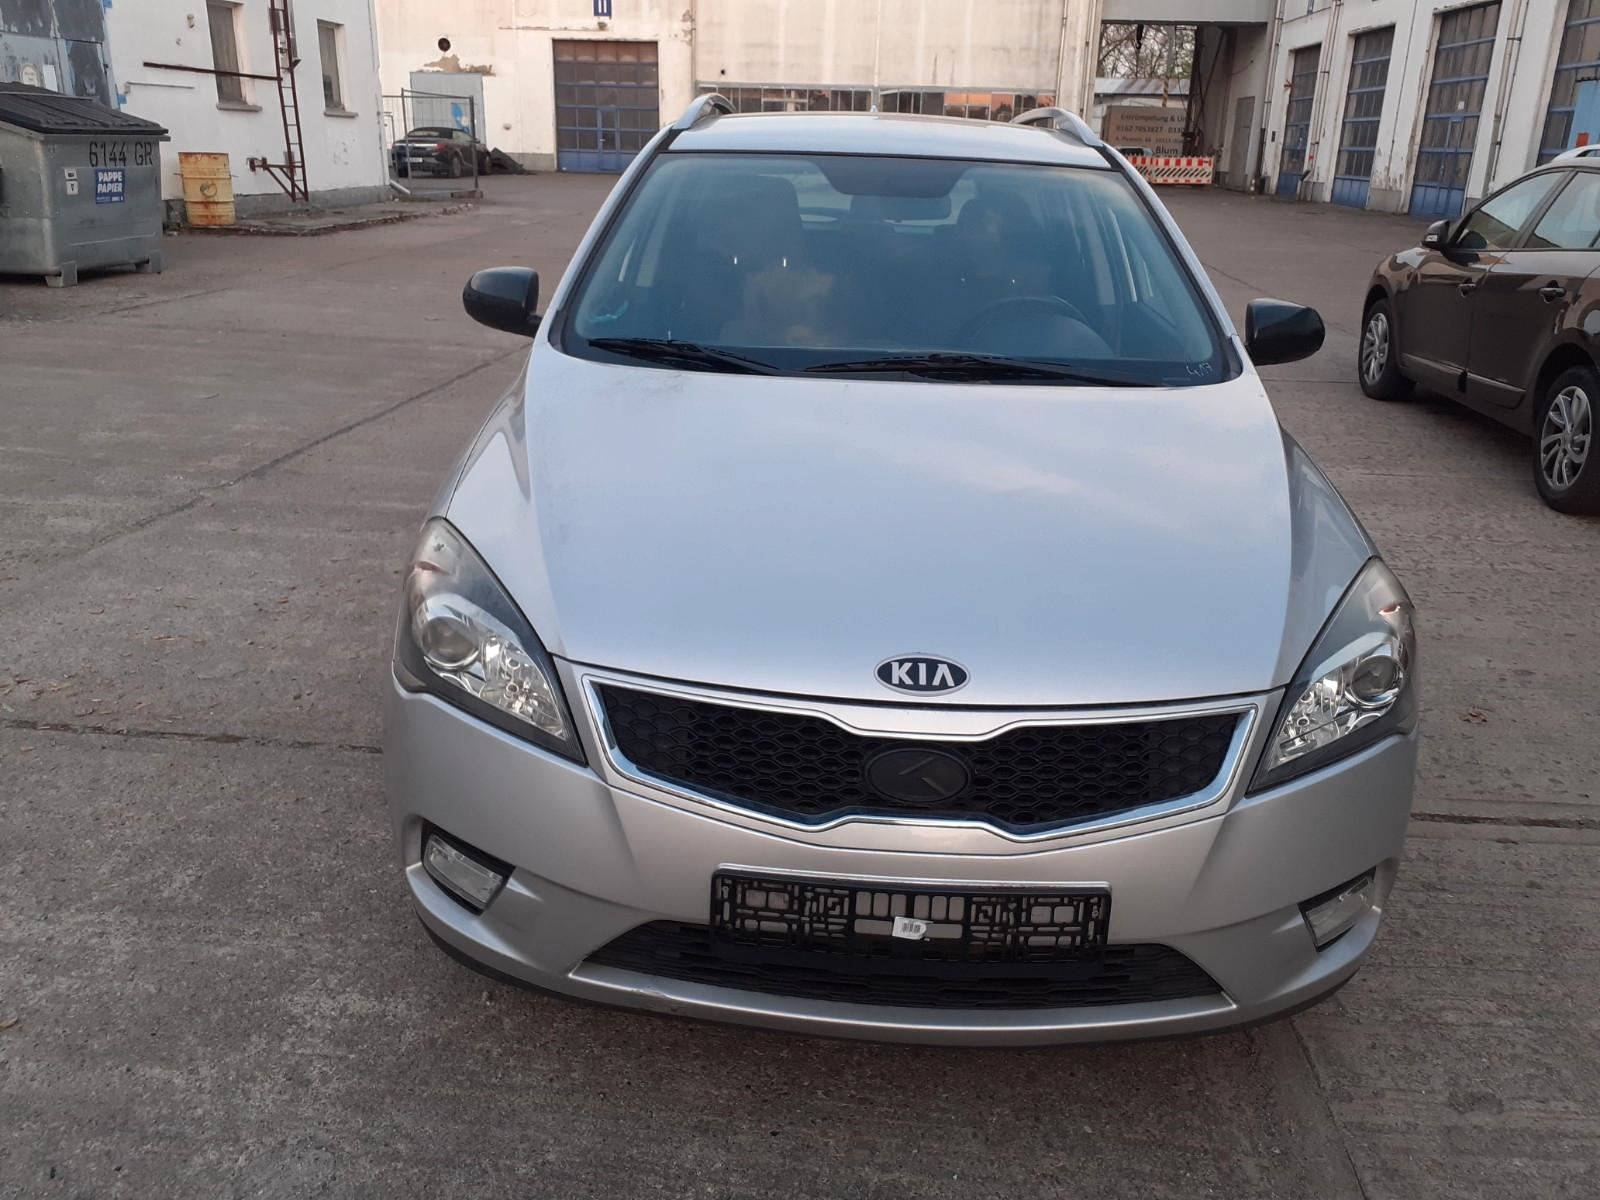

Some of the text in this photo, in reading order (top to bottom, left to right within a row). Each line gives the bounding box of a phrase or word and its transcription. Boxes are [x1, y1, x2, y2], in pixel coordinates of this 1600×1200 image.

[89, 141, 153, 167] 6144 GR
[1155, 145, 1178, 155] Blum
[98, 171, 123, 182] PAPPE
[97, 183, 123, 194] PAPIER
[890, 661, 955, 687] KIA
